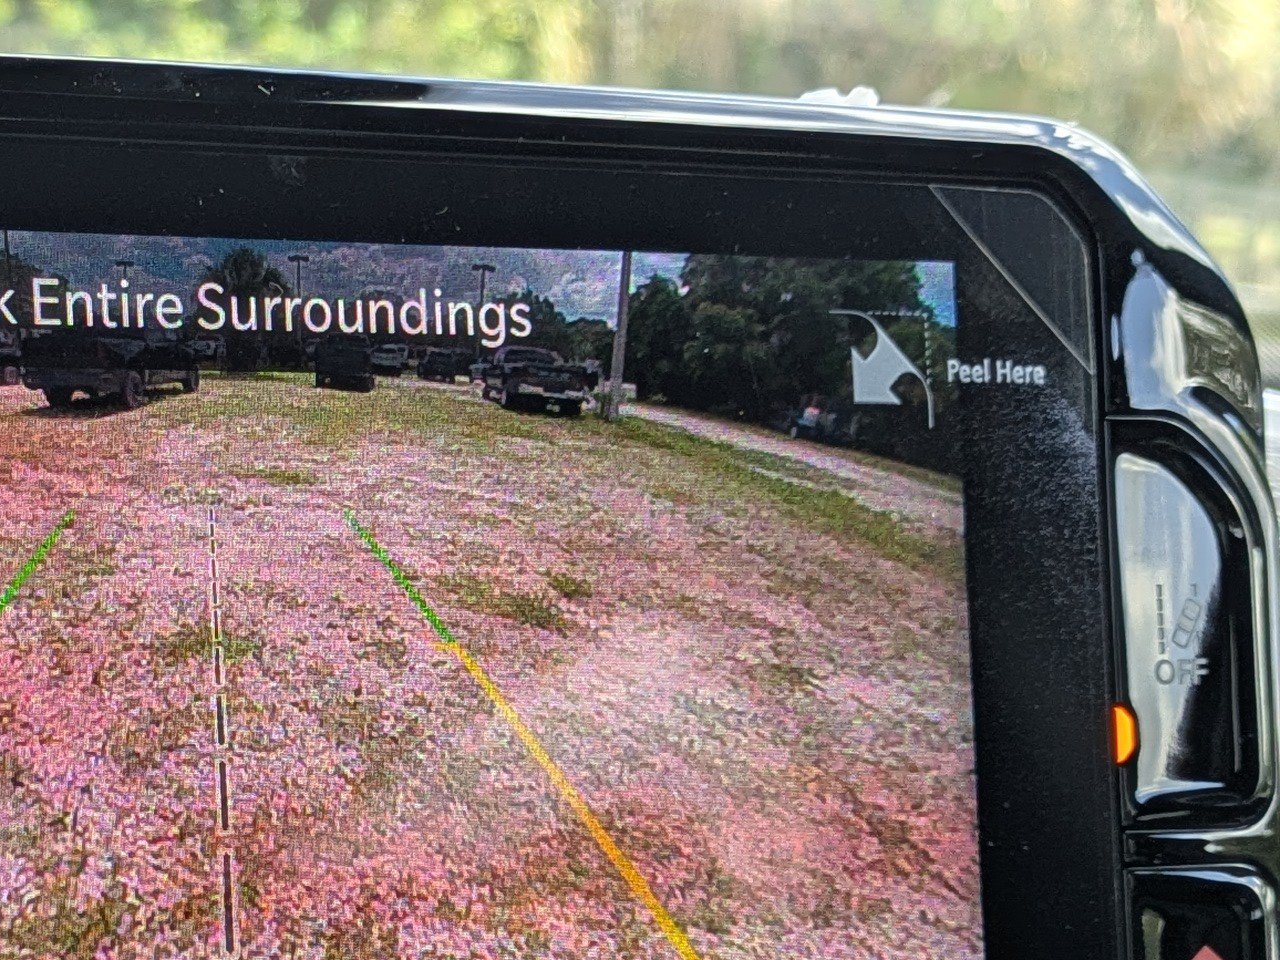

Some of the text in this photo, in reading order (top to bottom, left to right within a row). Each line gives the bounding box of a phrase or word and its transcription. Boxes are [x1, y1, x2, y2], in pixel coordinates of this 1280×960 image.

[32, 277, 184, 330] Entire
[197, 281, 533, 349] Surroundings
[946, 357, 1046, 386] Peel Here
[1154, 656, 1210, 686] OFF
